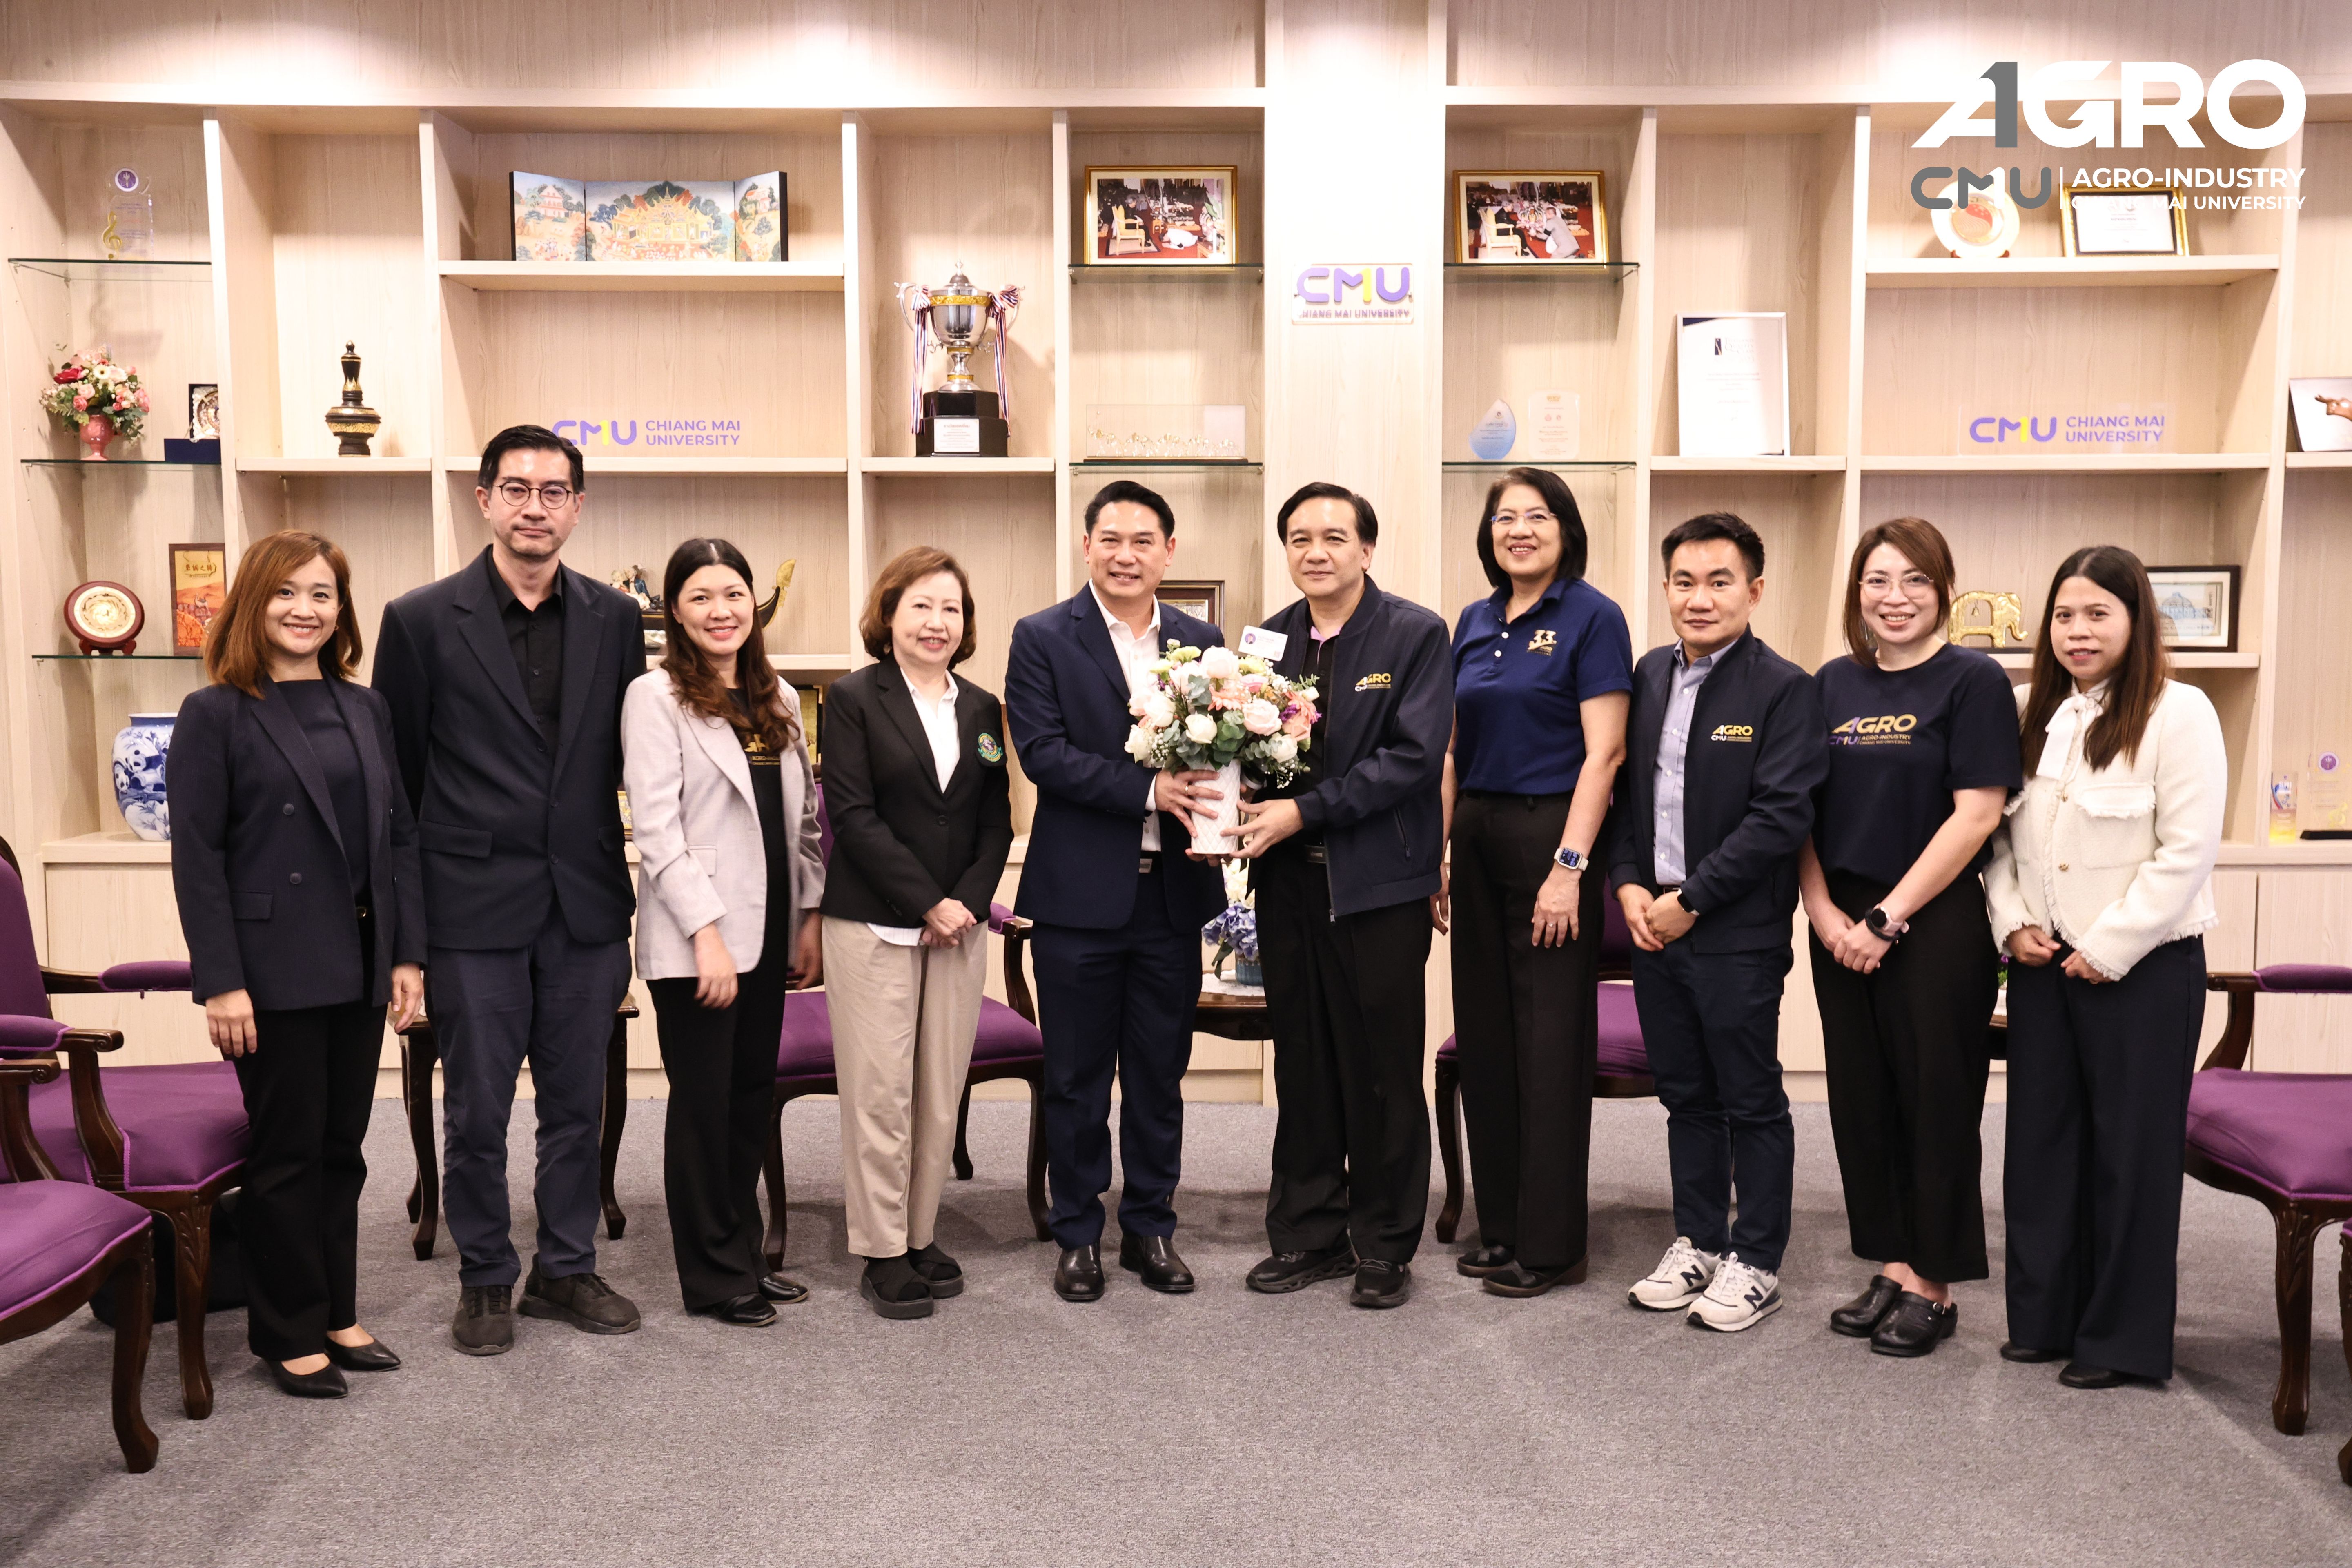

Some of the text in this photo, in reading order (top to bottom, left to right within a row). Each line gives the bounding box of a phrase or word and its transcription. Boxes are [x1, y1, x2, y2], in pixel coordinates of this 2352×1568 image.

[1297, 267, 1410, 303] CMU
[1297, 309, 1410, 318] HIANG MAI UNIVERSITY
[646, 420, 741, 431] CHIANG MAI
[2066, 415, 2165, 428] CHIANG MAI
[552, 420, 637, 446] CMU
[1970, 416, 2057, 443] CMU
[646, 434, 740, 446] UNIVERSITY
[2065, 430, 2163, 442] UNIVERSITY
